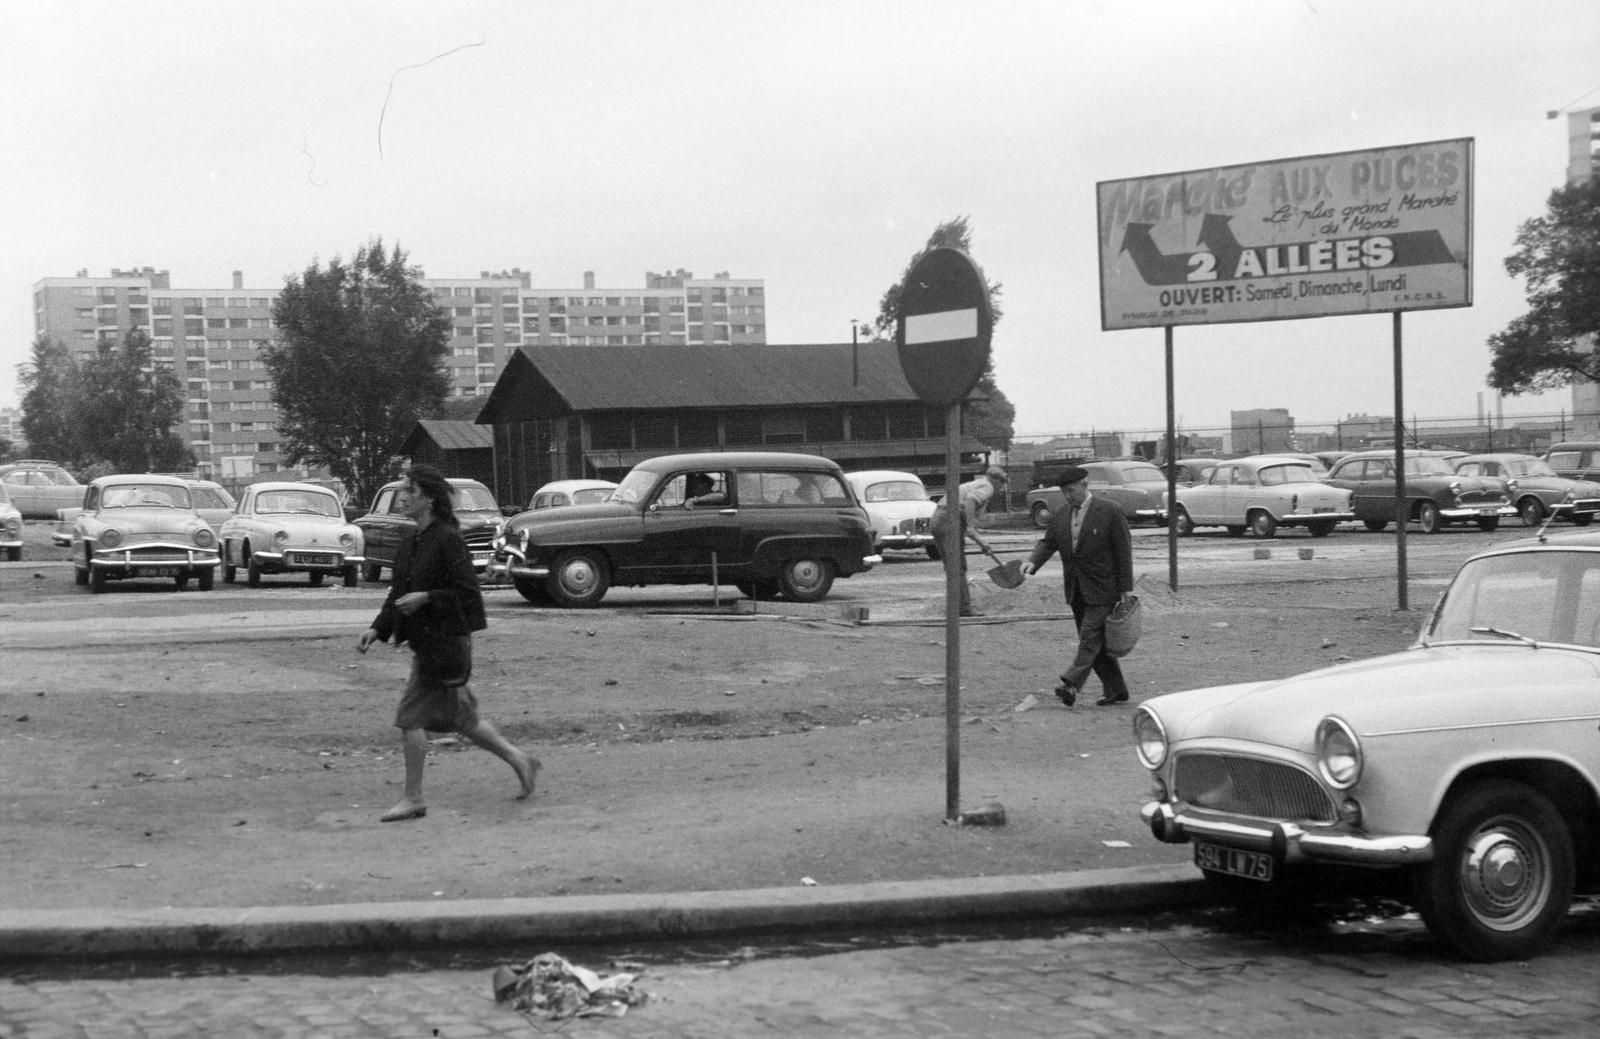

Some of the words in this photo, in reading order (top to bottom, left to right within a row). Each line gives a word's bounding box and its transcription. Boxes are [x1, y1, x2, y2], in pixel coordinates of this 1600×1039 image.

[1270, 164, 1333, 203] AUX
[1351, 151, 1459, 196] PUCES
[1262, 205, 1292, 224] Le
[1298, 201, 1335, 229] plus
[1341, 198, 1391, 223] grand
[1398, 191, 1460, 211] Marché
[1320, 220, 1338, 234] du
[1350, 216, 1399, 231] Monde
[1186, 252, 1218, 282] 2
[1234, 236, 1395, 278] ALLÉES
[1159, 284, 1241, 307] OUVERT:
[1246, 279, 1297, 302] Samedi,
[1300, 276, 1368, 298] Dimanche,
[1370, 273, 1406, 292] Lundi
[1248, 854, 1267, 878] 75
